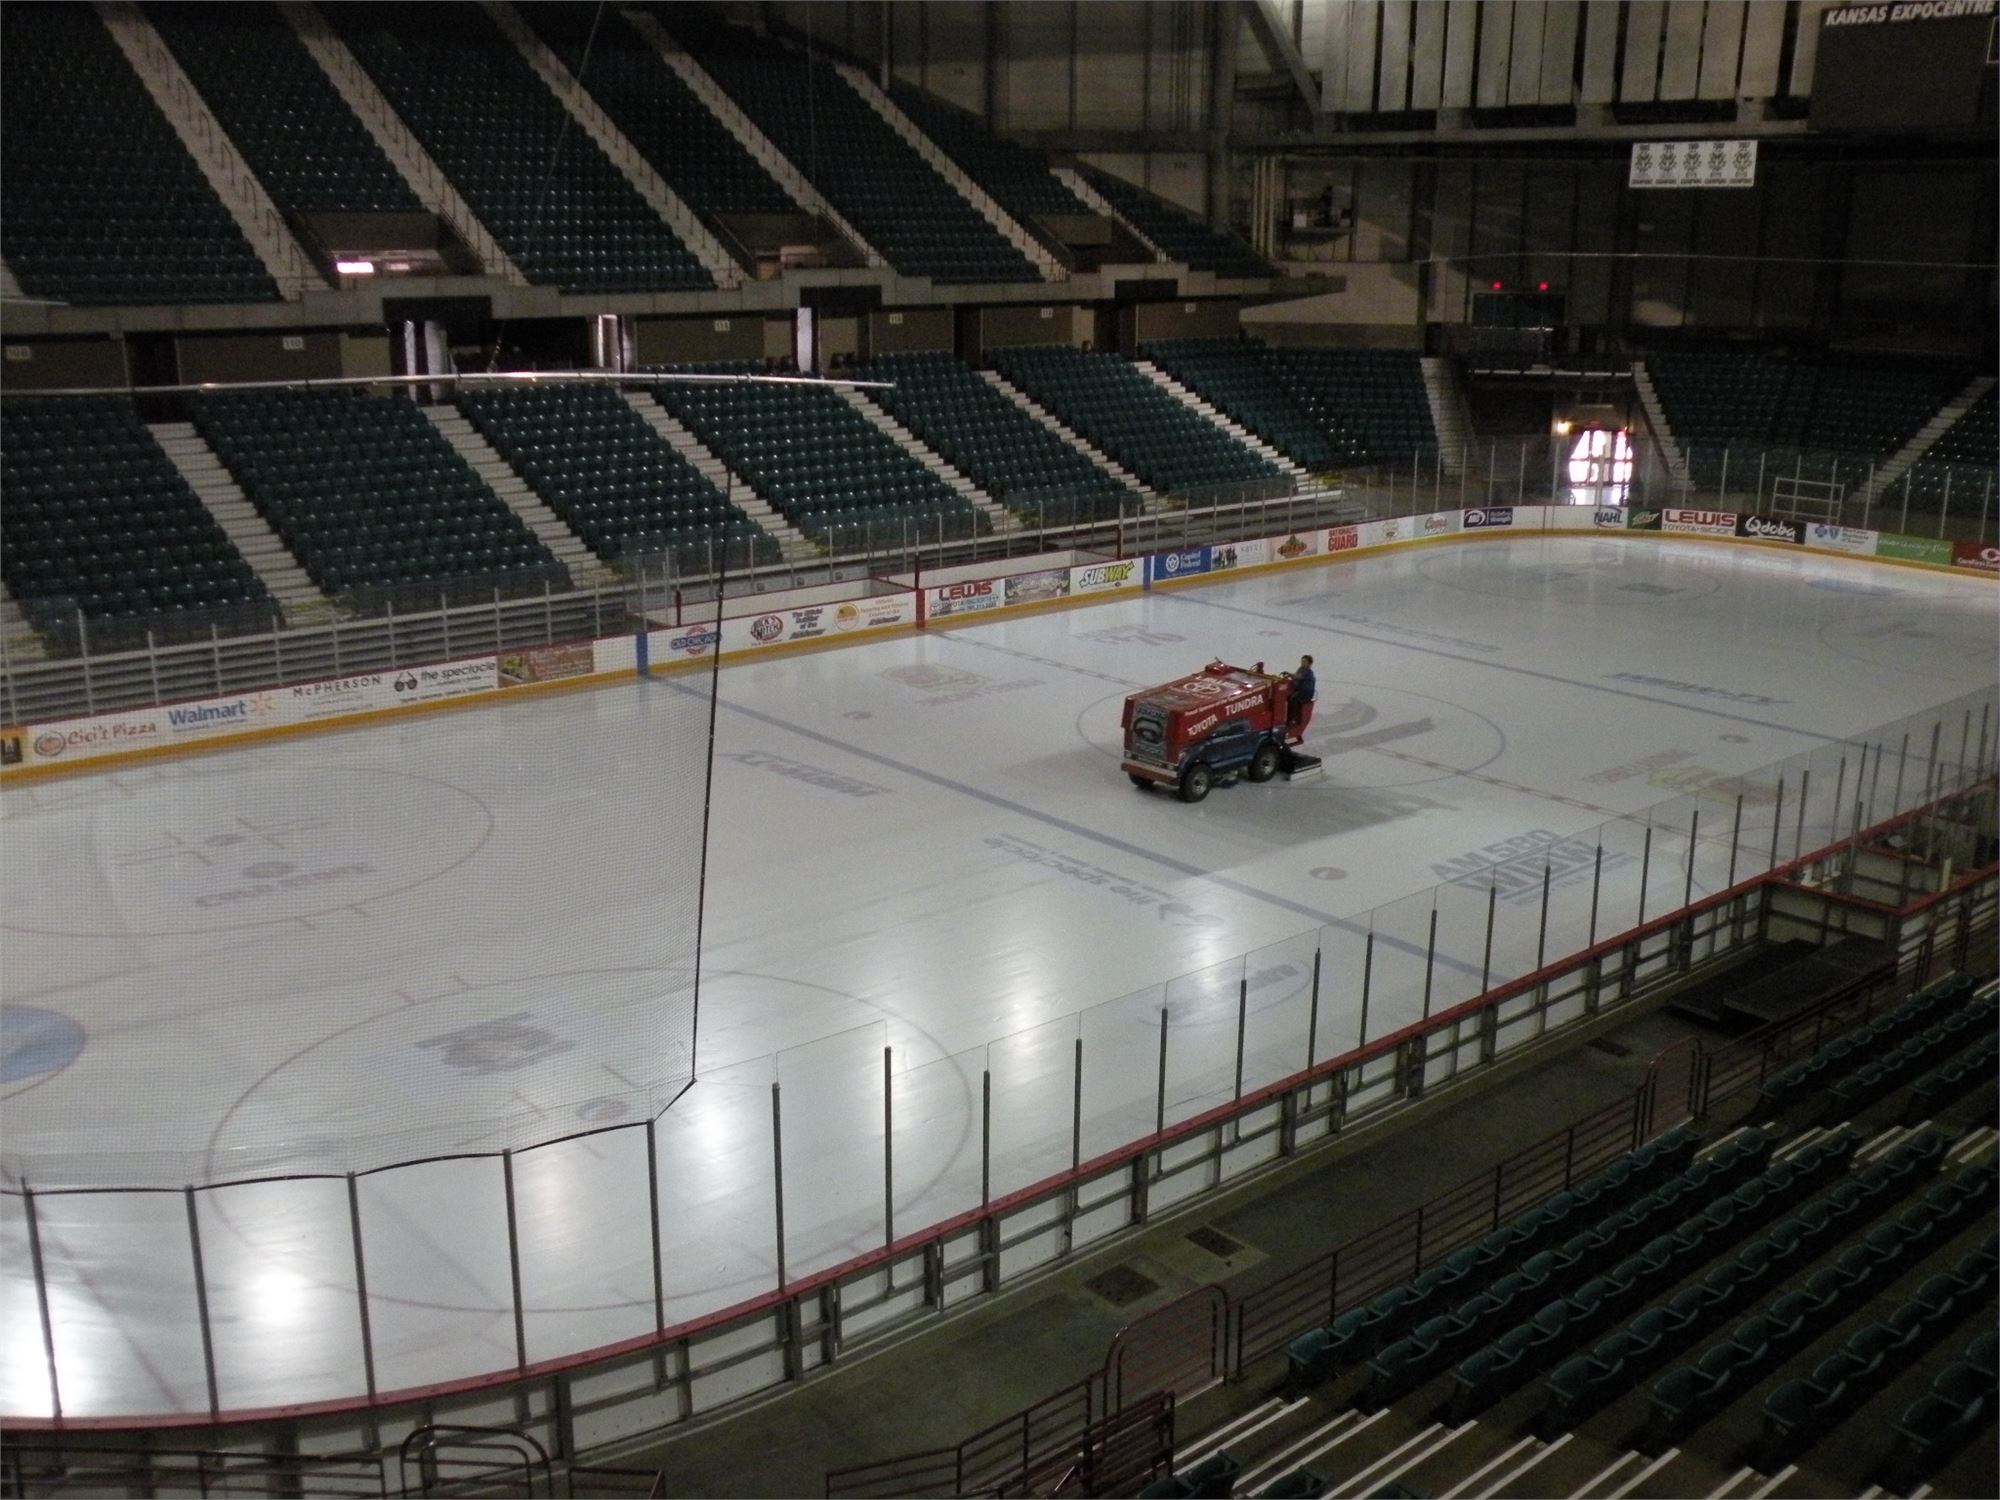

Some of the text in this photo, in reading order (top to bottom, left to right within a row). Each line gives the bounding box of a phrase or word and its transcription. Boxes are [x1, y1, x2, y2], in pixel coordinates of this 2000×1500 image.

[1825, 1, 1995, 26] KANSAS EXPOCENTRE
[1594, 511, 1623, 524] NAHL
[1663, 523, 1697, 532] TOYOTA
[1665, 510, 1735, 527] LEWIS
[1745, 515, 1796, 538] Qdoba
[1328, 533, 1358, 552] GUARD
[1079, 561, 1134, 588] SUBWAY
[939, 582, 993, 601] LEWIS
[421, 661, 496, 681] the spectacle
[293, 676, 381, 698] McPHERSON
[168, 700, 247, 725] Walmart
[1225, 694, 1264, 716] TUNDRA
[67, 726, 108, 746] Cici's
[112, 722, 157, 738] Pizza
[1187, 714, 1218, 736] TOYOTA
